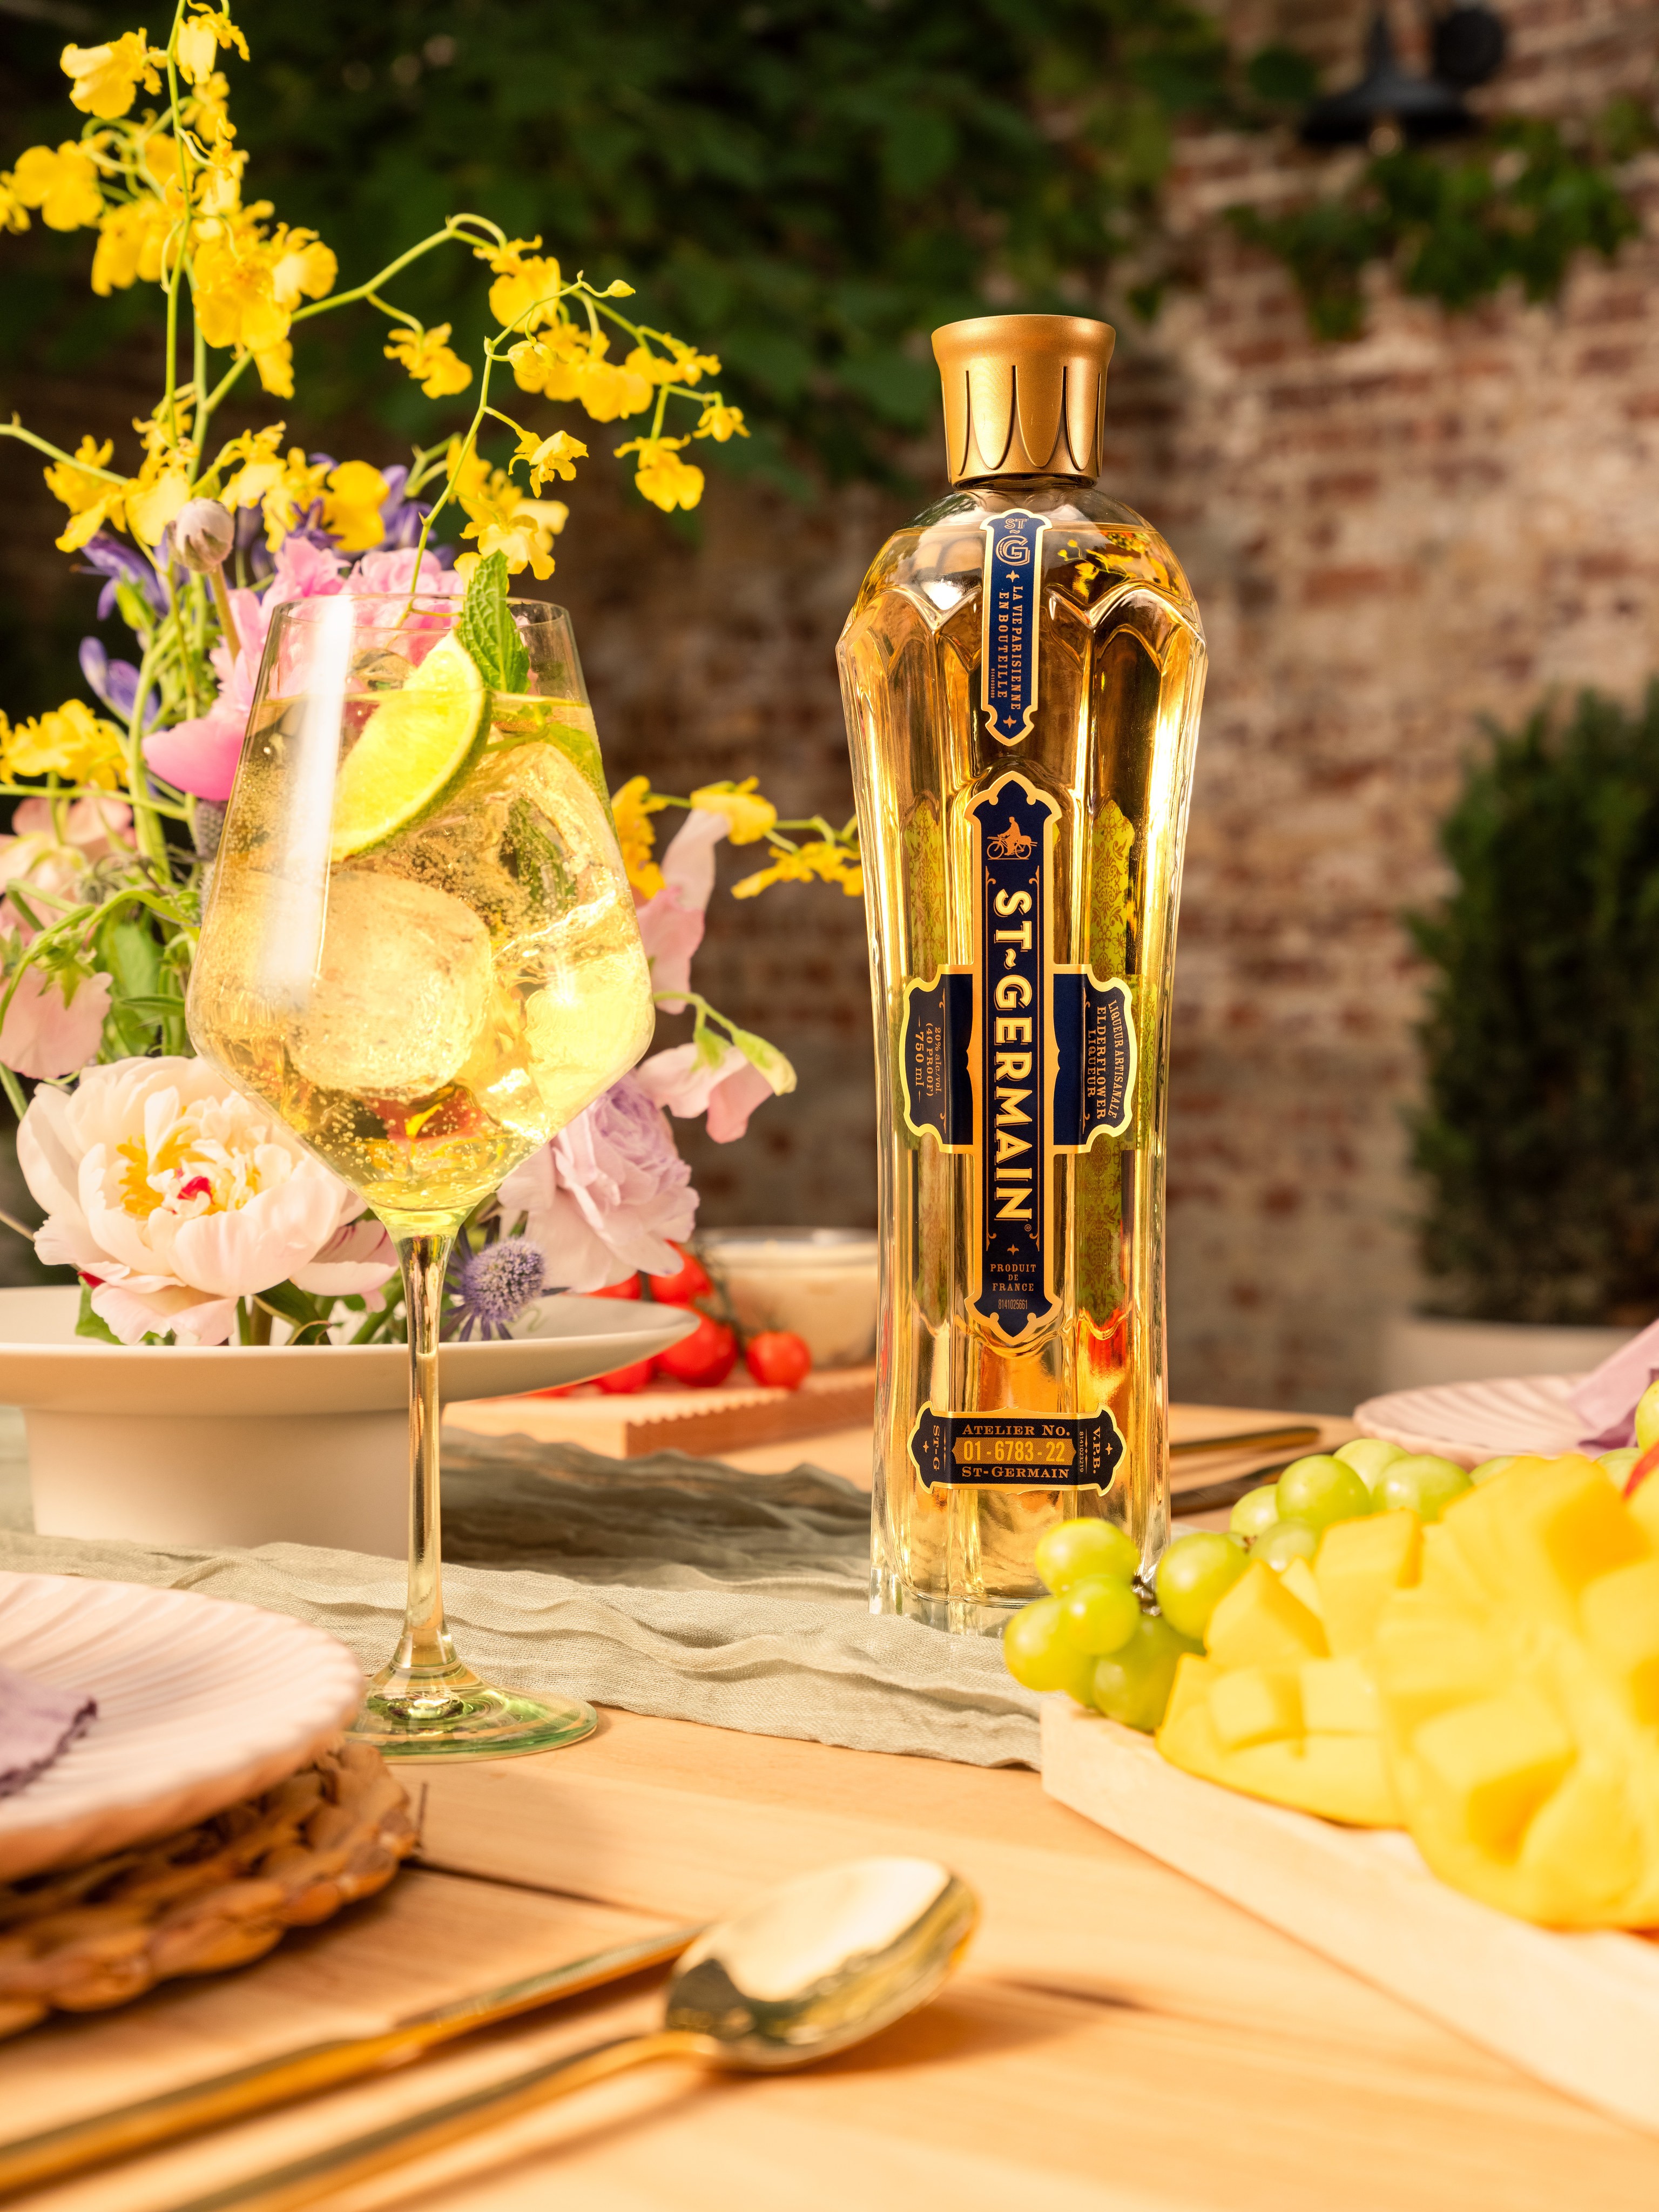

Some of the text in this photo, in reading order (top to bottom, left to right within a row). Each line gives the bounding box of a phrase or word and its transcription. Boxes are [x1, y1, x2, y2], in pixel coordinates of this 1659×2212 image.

[1004, 517, 1029, 529] ST
[995, 535, 1030, 566] G
[997, 592, 1009, 698] EN BOUTEILLE
[1011, 586, 1023, 710] LA VIE PARISIENNE
[915, 1031, 925, 1087] 750 ml
[1087, 1029, 1096, 1097] LIQUEUR
[1097, 1006, 1107, 1119] ELDERFLOWER
[1108, 1000, 1124, 1119] LIQUEUR ARTISANALE
[990, 1264, 1036, 1272] PRODUIT
[992, 1283, 1034, 1291] FRANCE
[998, 1299, 1028, 1310] 8141025661
[962, 1424, 1035, 1435] ATELIER
[962, 1466, 1069, 1479] ST-GERMAIN
